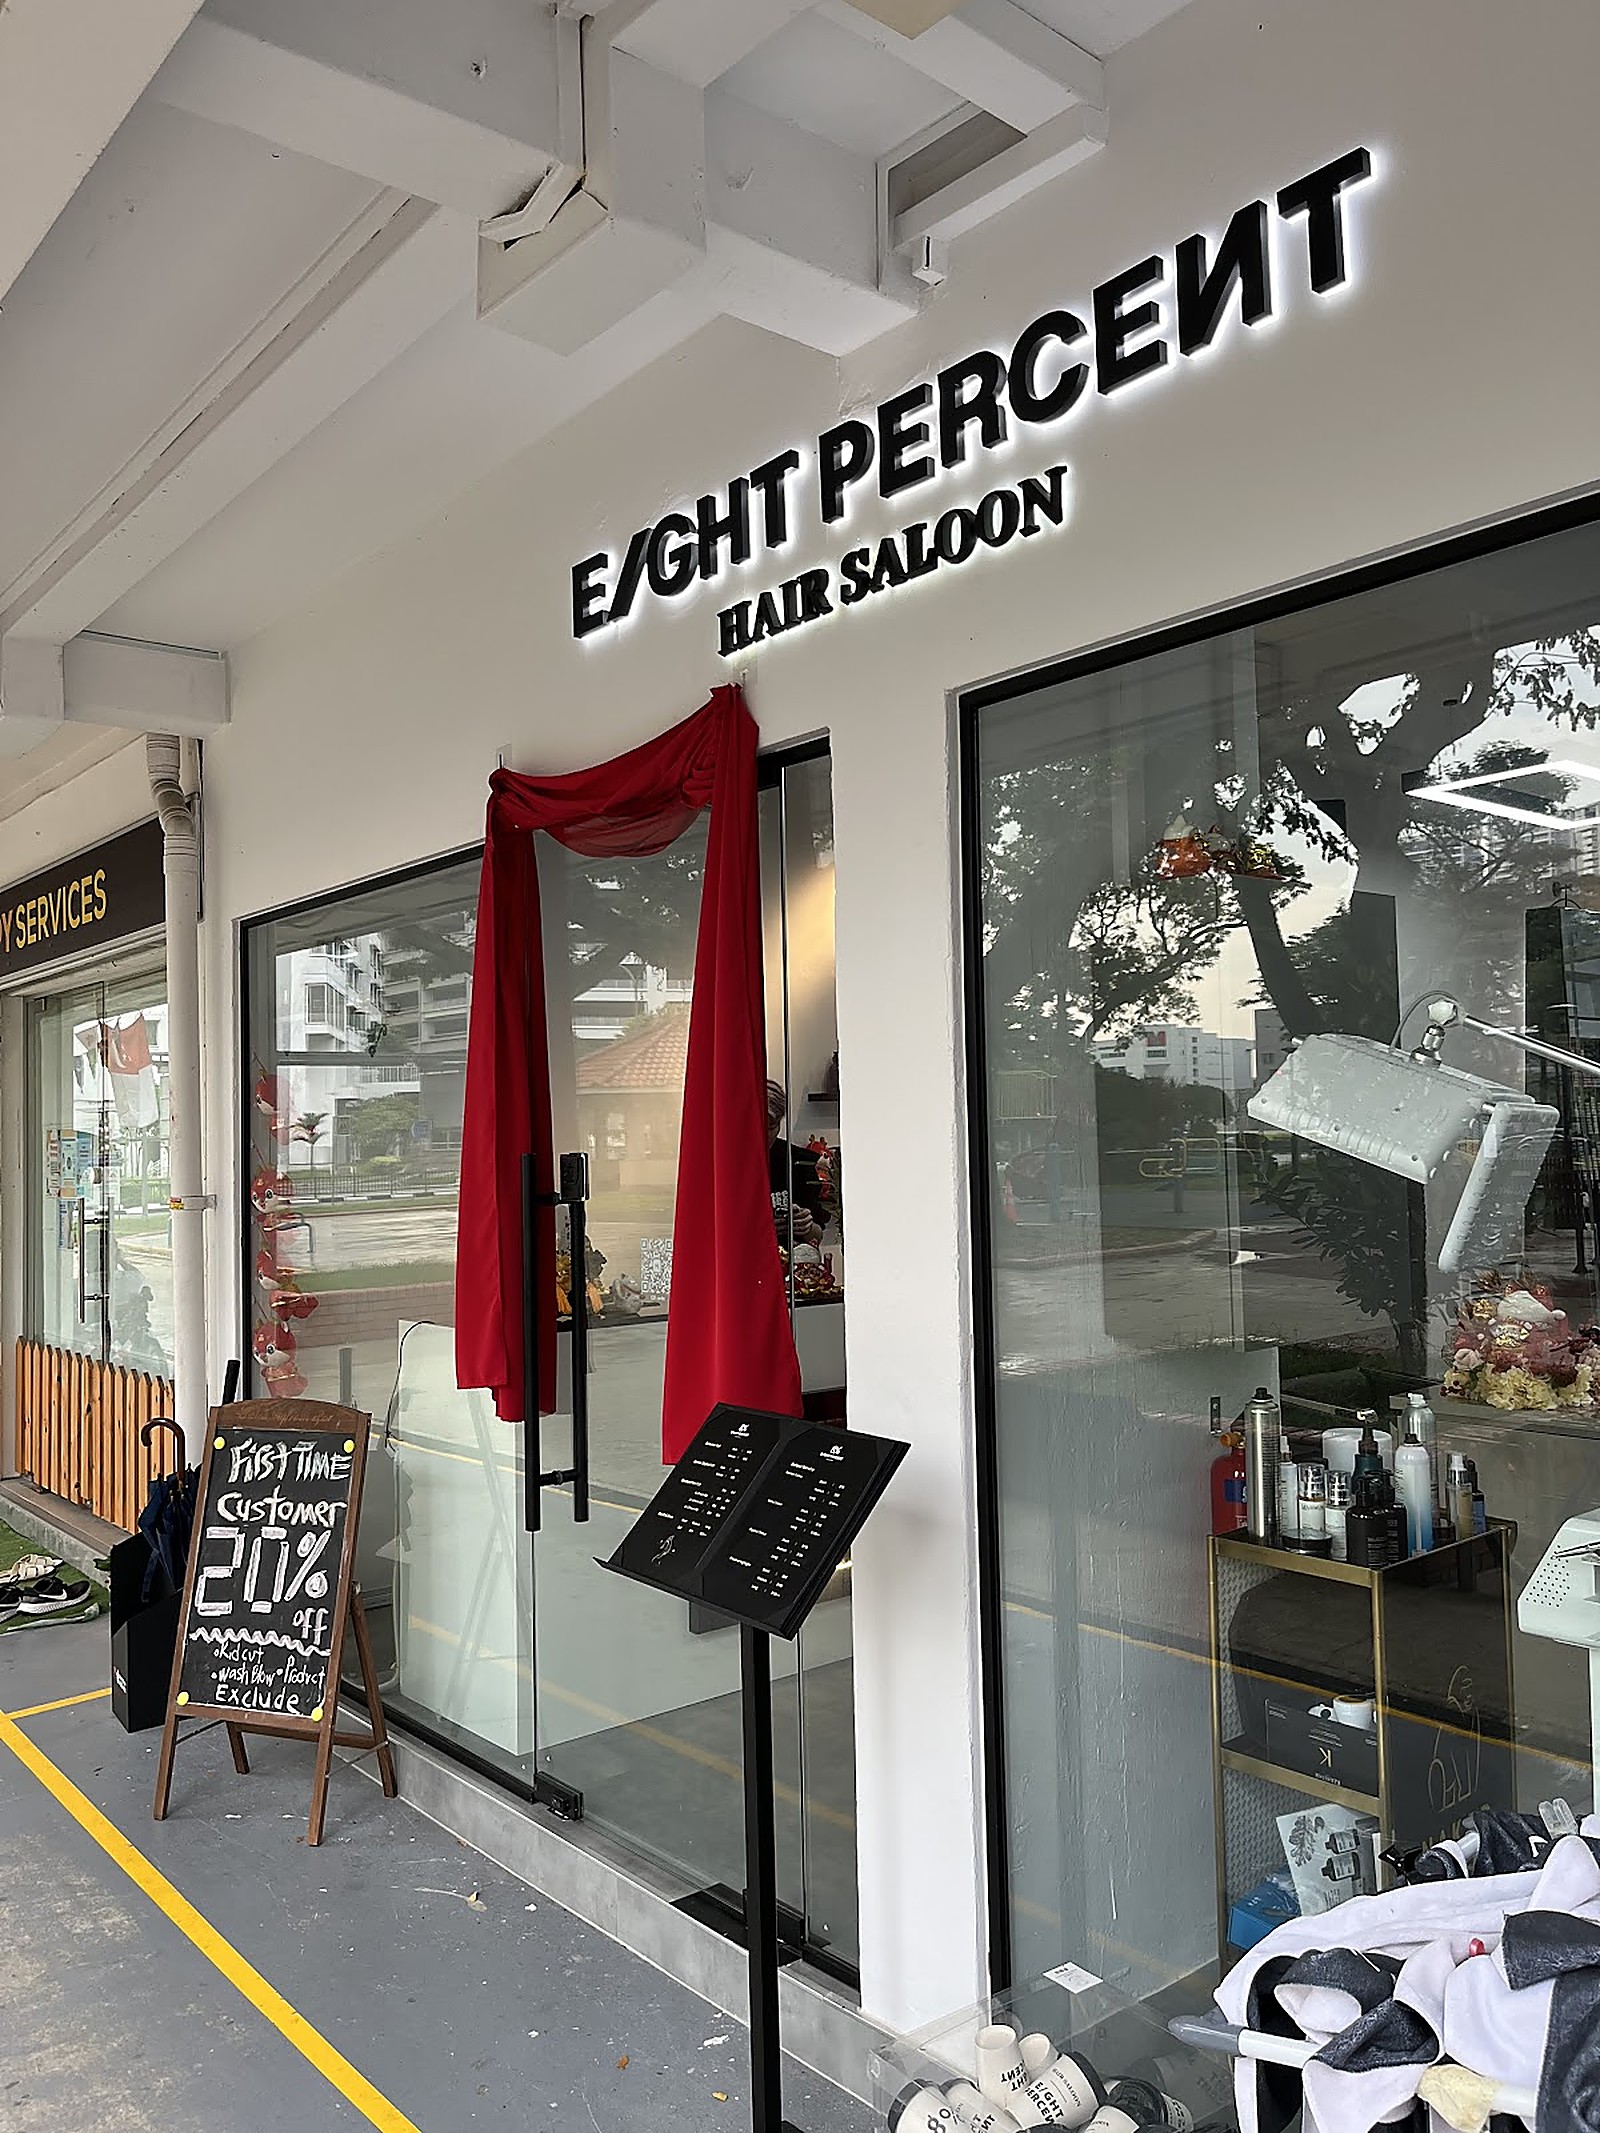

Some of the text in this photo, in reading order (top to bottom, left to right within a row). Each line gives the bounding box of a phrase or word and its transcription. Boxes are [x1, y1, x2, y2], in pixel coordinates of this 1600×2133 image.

[717, 465, 1068, 657] HAIR SALOON
[0, 868, 107, 953] Y SERVICES
[195, 1526, 332, 1616] 20%
[292, 1607, 329, 1646] off
[215, 1684, 303, 1717] Exclude
